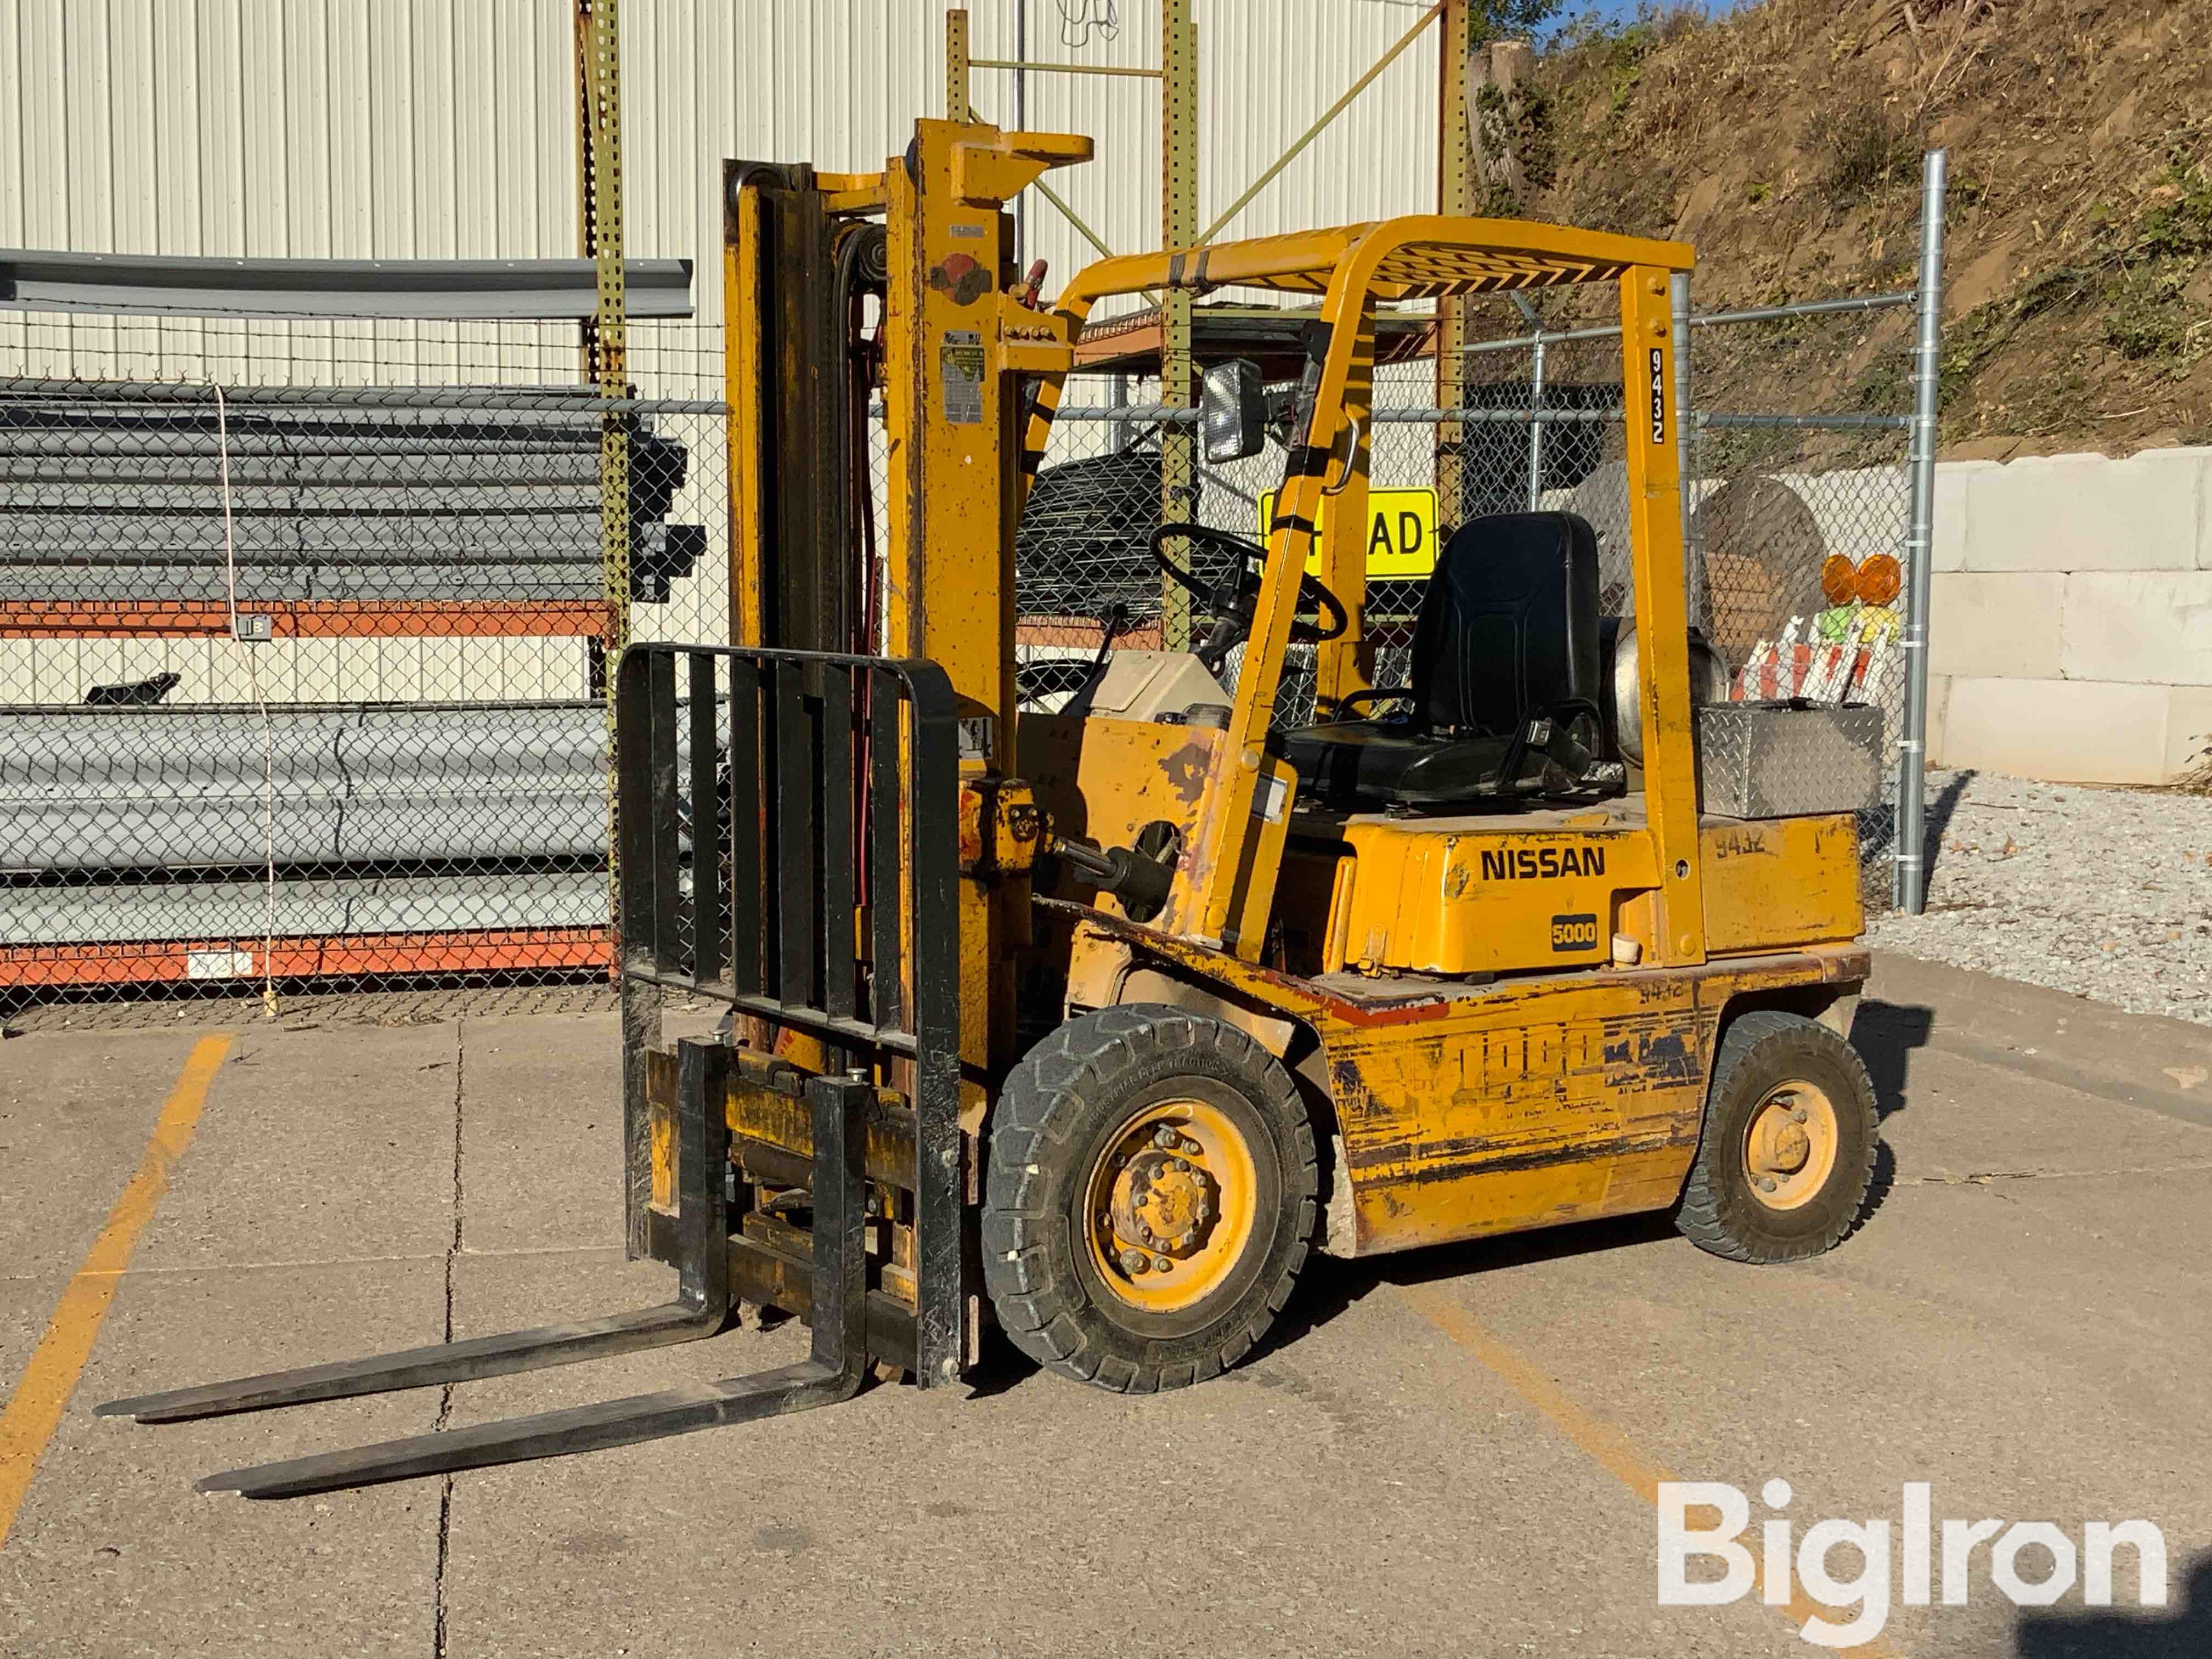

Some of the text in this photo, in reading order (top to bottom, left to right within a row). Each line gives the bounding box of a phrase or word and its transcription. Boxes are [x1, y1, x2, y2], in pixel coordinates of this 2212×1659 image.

[1652, 351, 1663, 443] 9432
[1481, 847, 1605, 881] NISSAN
[1553, 923, 1596, 944] 5000
